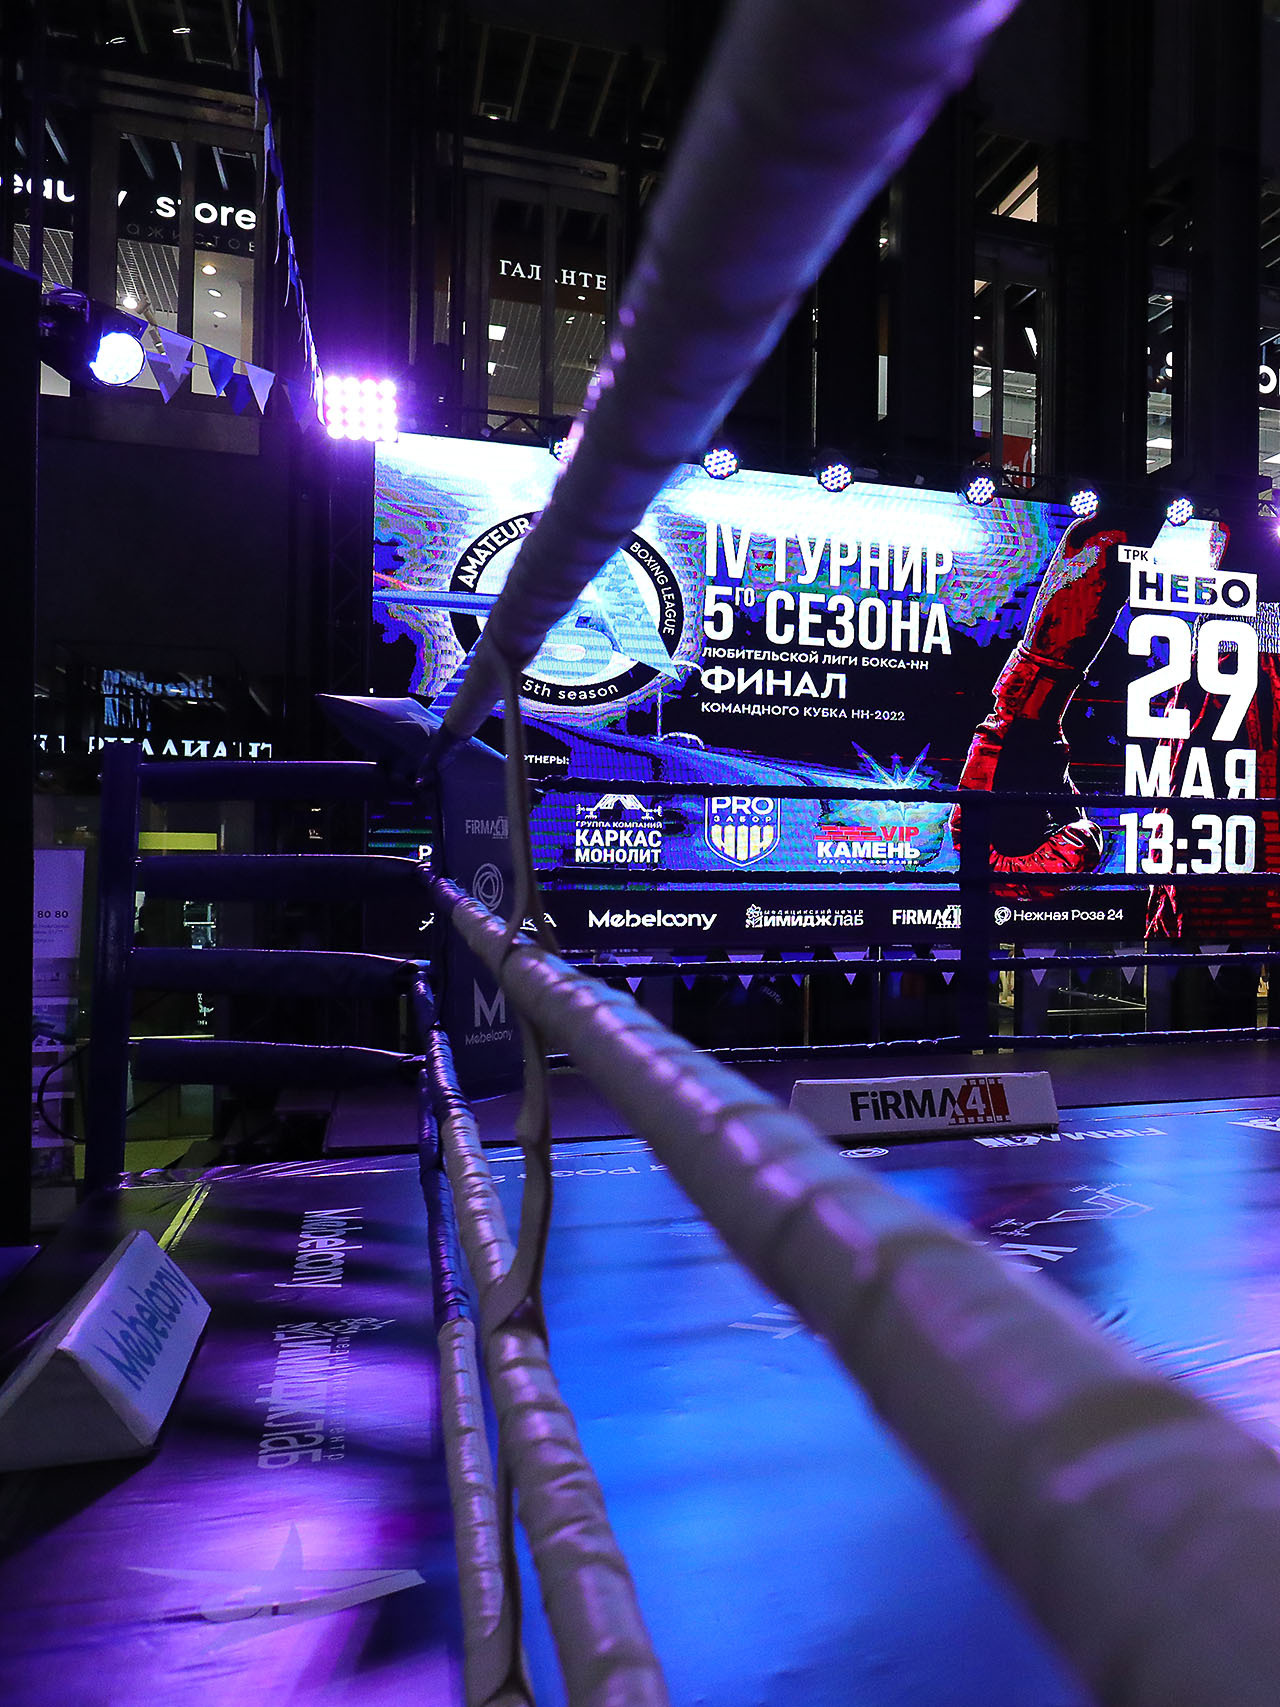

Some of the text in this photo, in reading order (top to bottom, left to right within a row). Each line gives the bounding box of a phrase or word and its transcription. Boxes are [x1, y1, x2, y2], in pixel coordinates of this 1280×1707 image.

[154, 195, 257, 230] sore
[499, 259, 608, 291] ГАЛНТЕ
[455, 516, 534, 589] AMATEUR
[705, 522, 954, 595] IV ТУРНИР
[1123, 548, 1149, 563] ТРК
[629, 541, 677, 636] BOXING LEAGUE
[1138, 569, 1252, 610] НЕБО
[765, 589, 953, 655] СЕЗОНА
[702, 646, 929, 671] ЛЮБИТЕЛЬСКОЙ ЛИГИ БОКСА-НН
[521, 679, 619, 701] 5th season
[701, 665, 848, 700] ФИНАЛ
[1126, 613, 1260, 742] 29
[701, 701, 906, 722] КОМАНДНОГО КУБКА НН-2022
[1124, 743, 1258, 800] МАЯ
[711, 795, 775, 815] PRO
[575, 828, 662, 848] КАРКАС
[816, 840, 922, 859] КАМЕНЬ
[880, 826, 918, 842] VIP
[1119, 811, 1257, 875] 13:30
[575, 847, 662, 863] МОНОЛИТ
[1013, 908, 1124, 921] Нежная Роза 24
